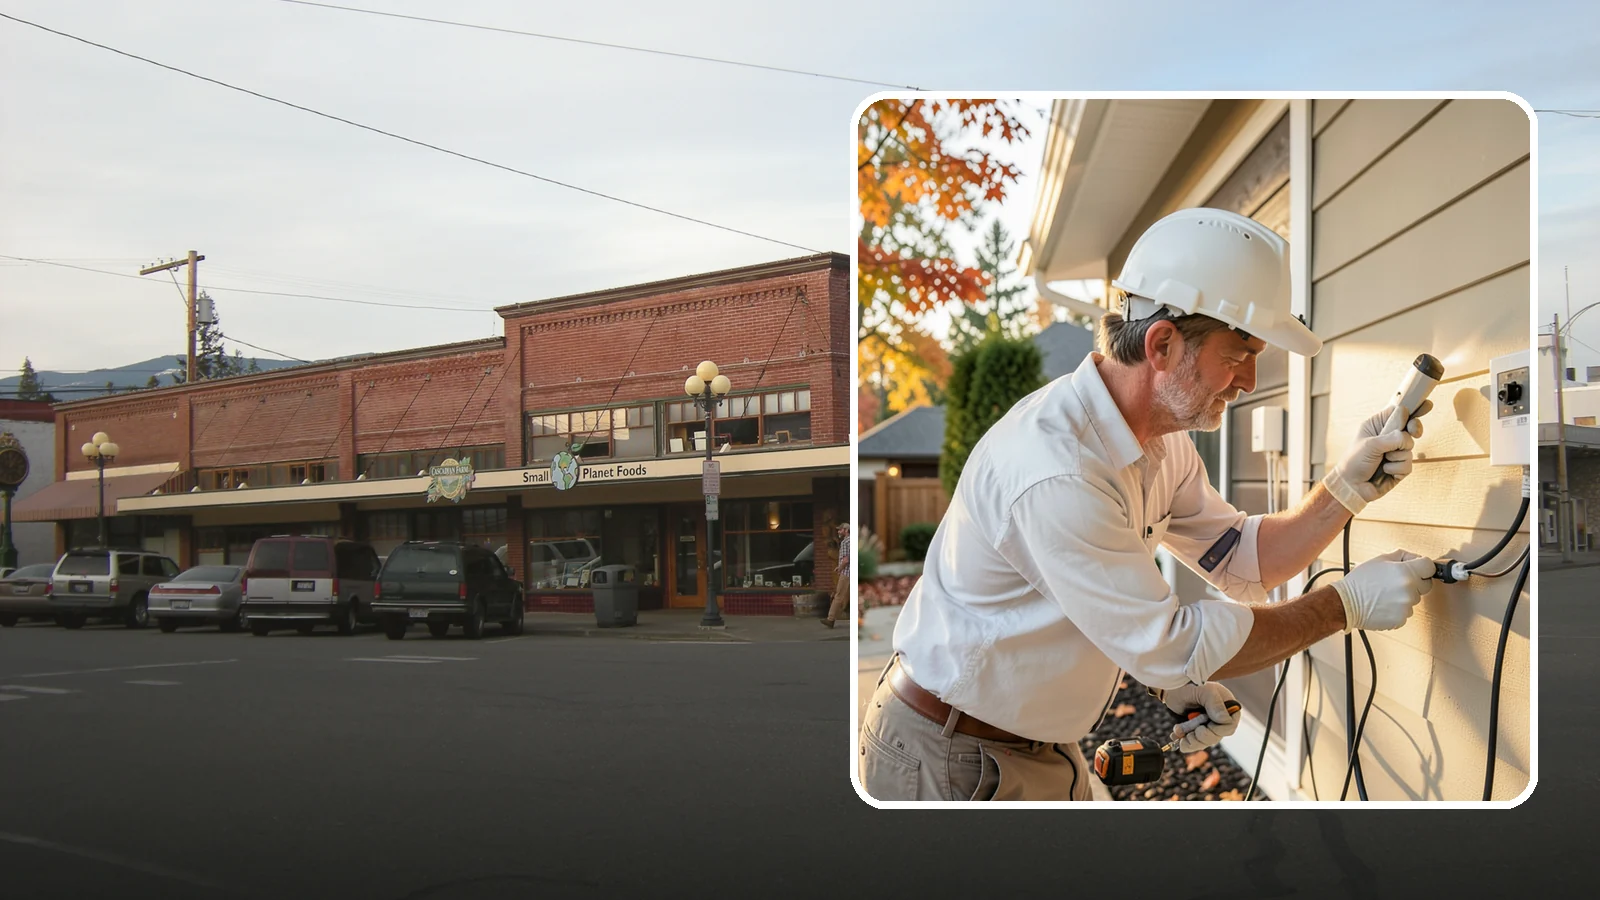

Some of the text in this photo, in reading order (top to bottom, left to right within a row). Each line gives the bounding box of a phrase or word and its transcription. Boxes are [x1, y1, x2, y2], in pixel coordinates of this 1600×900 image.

[431, 465, 469, 476] CASCADIAN FARM
[523, 464, 647, 483] Small Planet Foods
